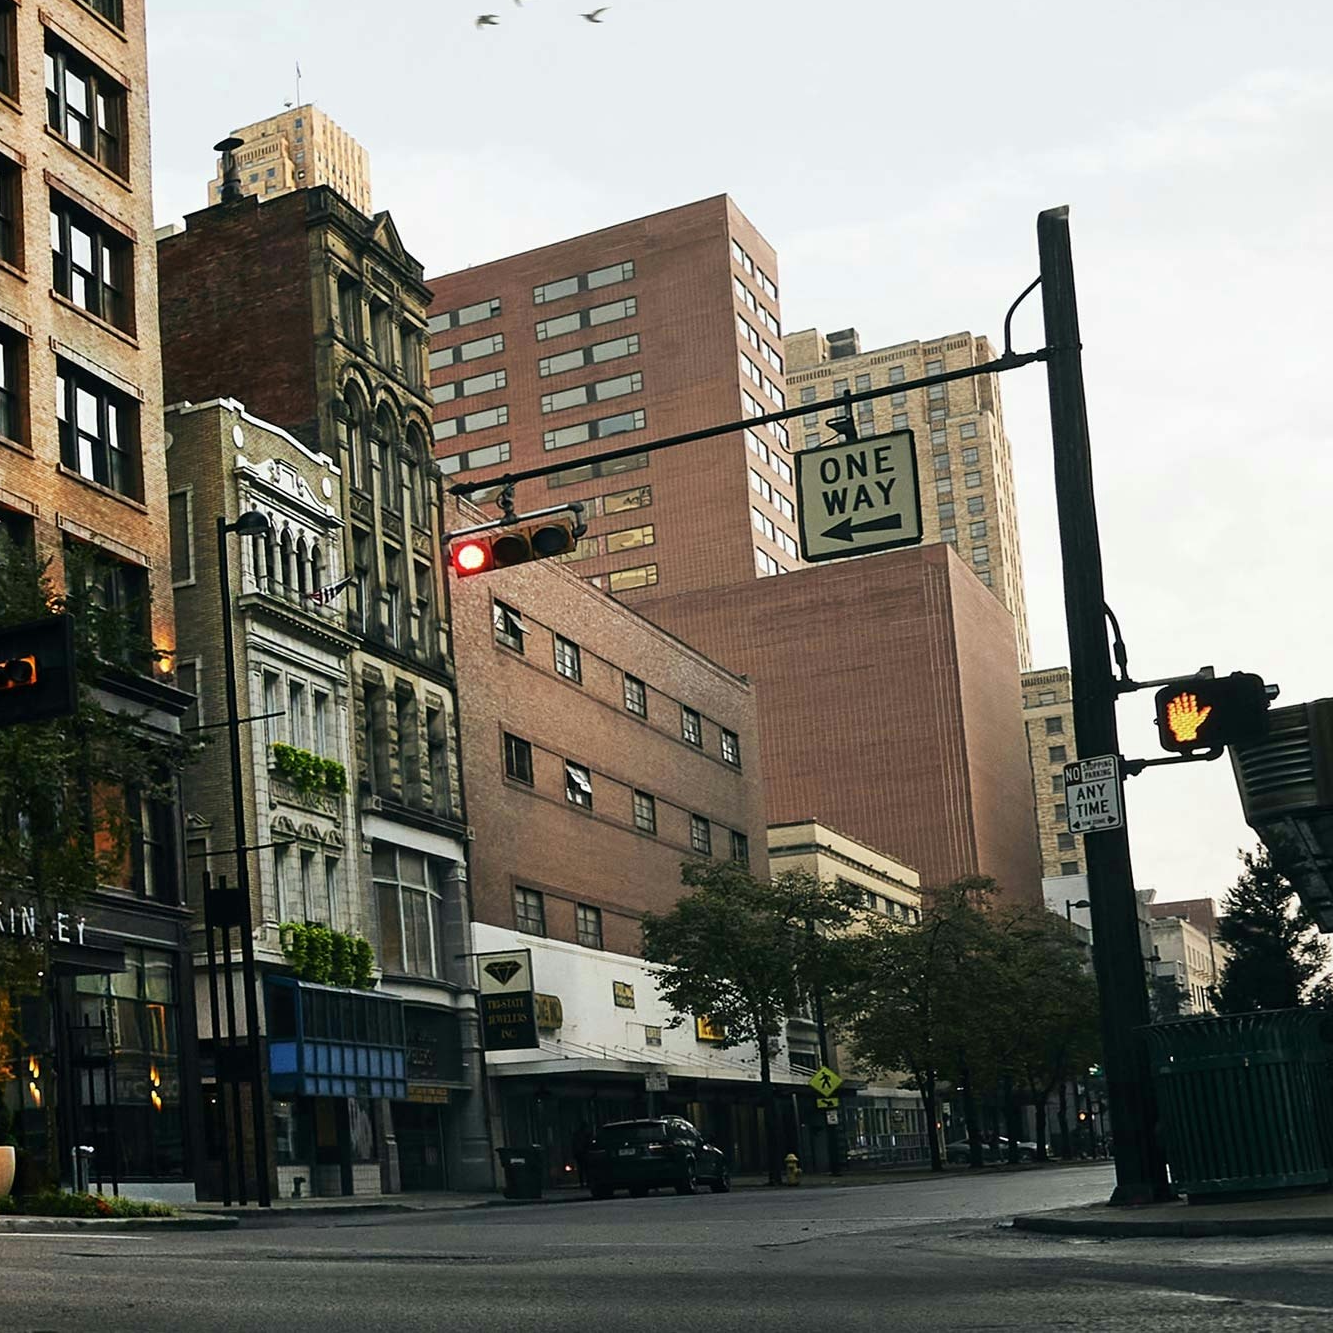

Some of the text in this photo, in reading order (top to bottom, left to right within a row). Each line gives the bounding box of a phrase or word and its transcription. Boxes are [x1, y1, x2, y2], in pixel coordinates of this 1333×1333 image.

[820, 445, 894, 484] ONE
[822, 478, 896, 516] WAY
[1065, 767, 1080, 782] NO
[1076, 783, 1106, 801] ANY
[1076, 799, 1110, 817] TIME
